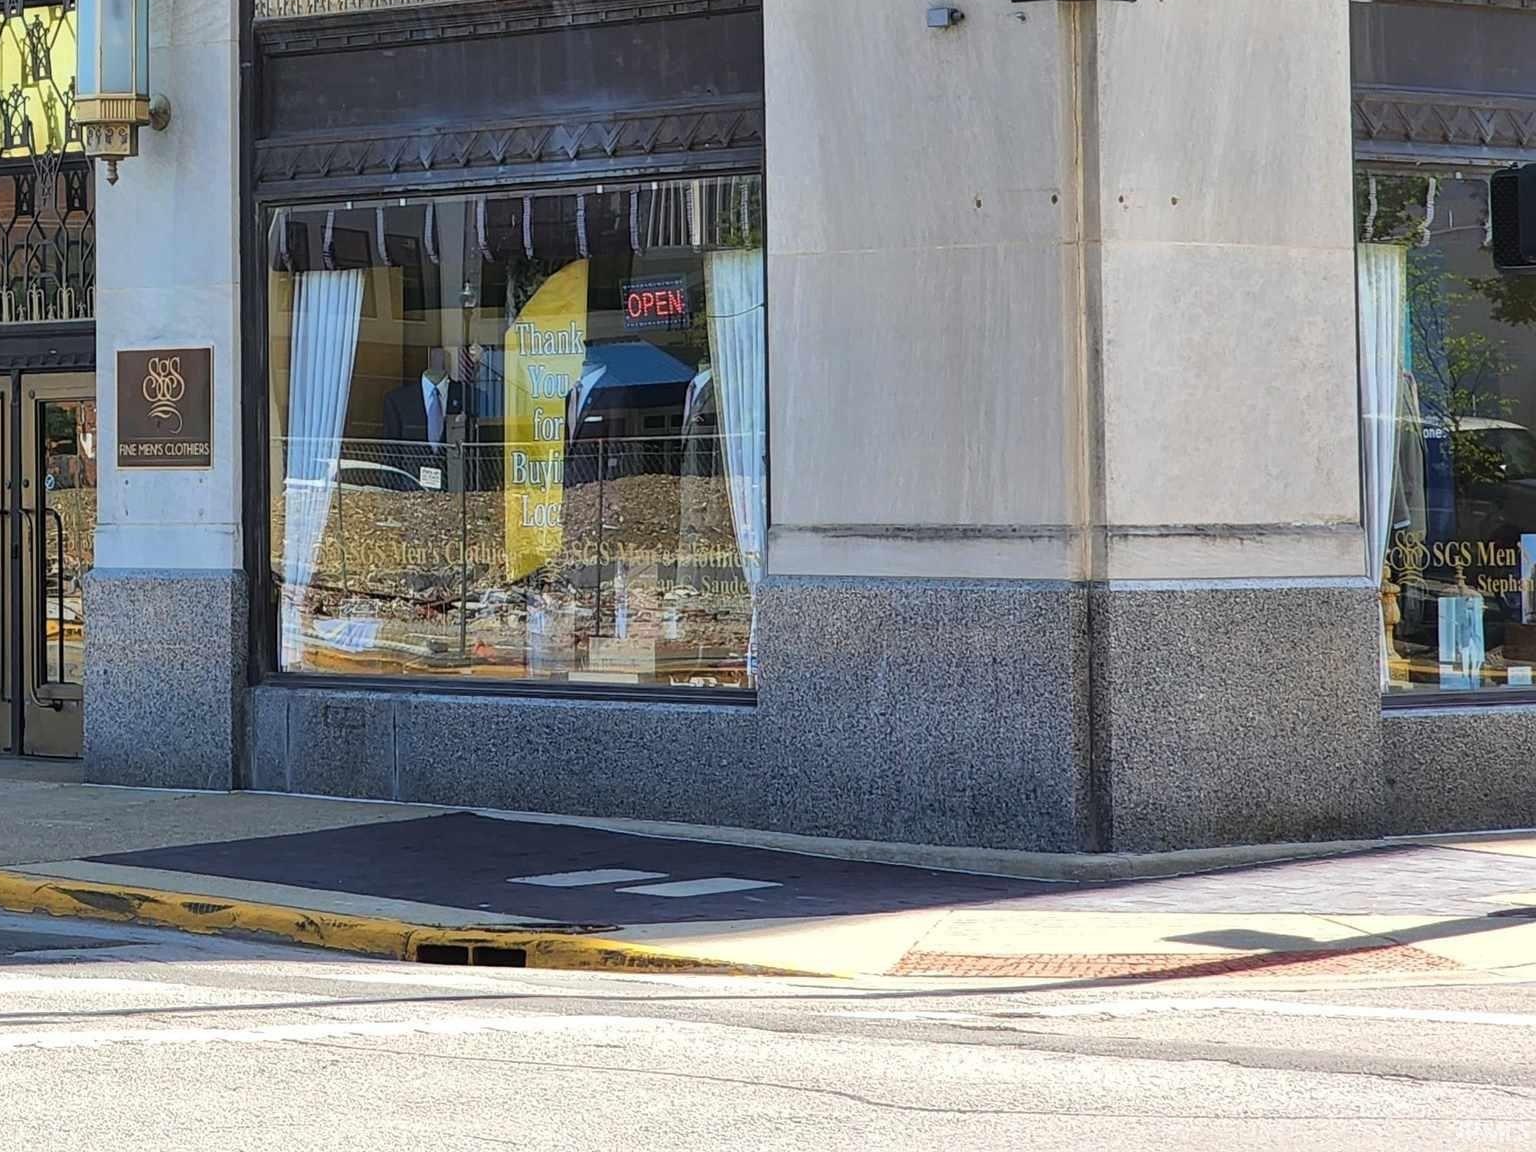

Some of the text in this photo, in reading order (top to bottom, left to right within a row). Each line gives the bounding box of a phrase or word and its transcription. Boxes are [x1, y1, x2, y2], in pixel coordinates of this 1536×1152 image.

[627, 290, 683, 318] OPEN
[515, 320, 585, 356] Thank
[527, 363, 570, 399] You
[533, 406, 565, 441] for
[119, 443, 137, 456] FINE
[164, 442, 210, 456] CLOTHIERS
[1432, 541, 1524, 567] SGS Men'
